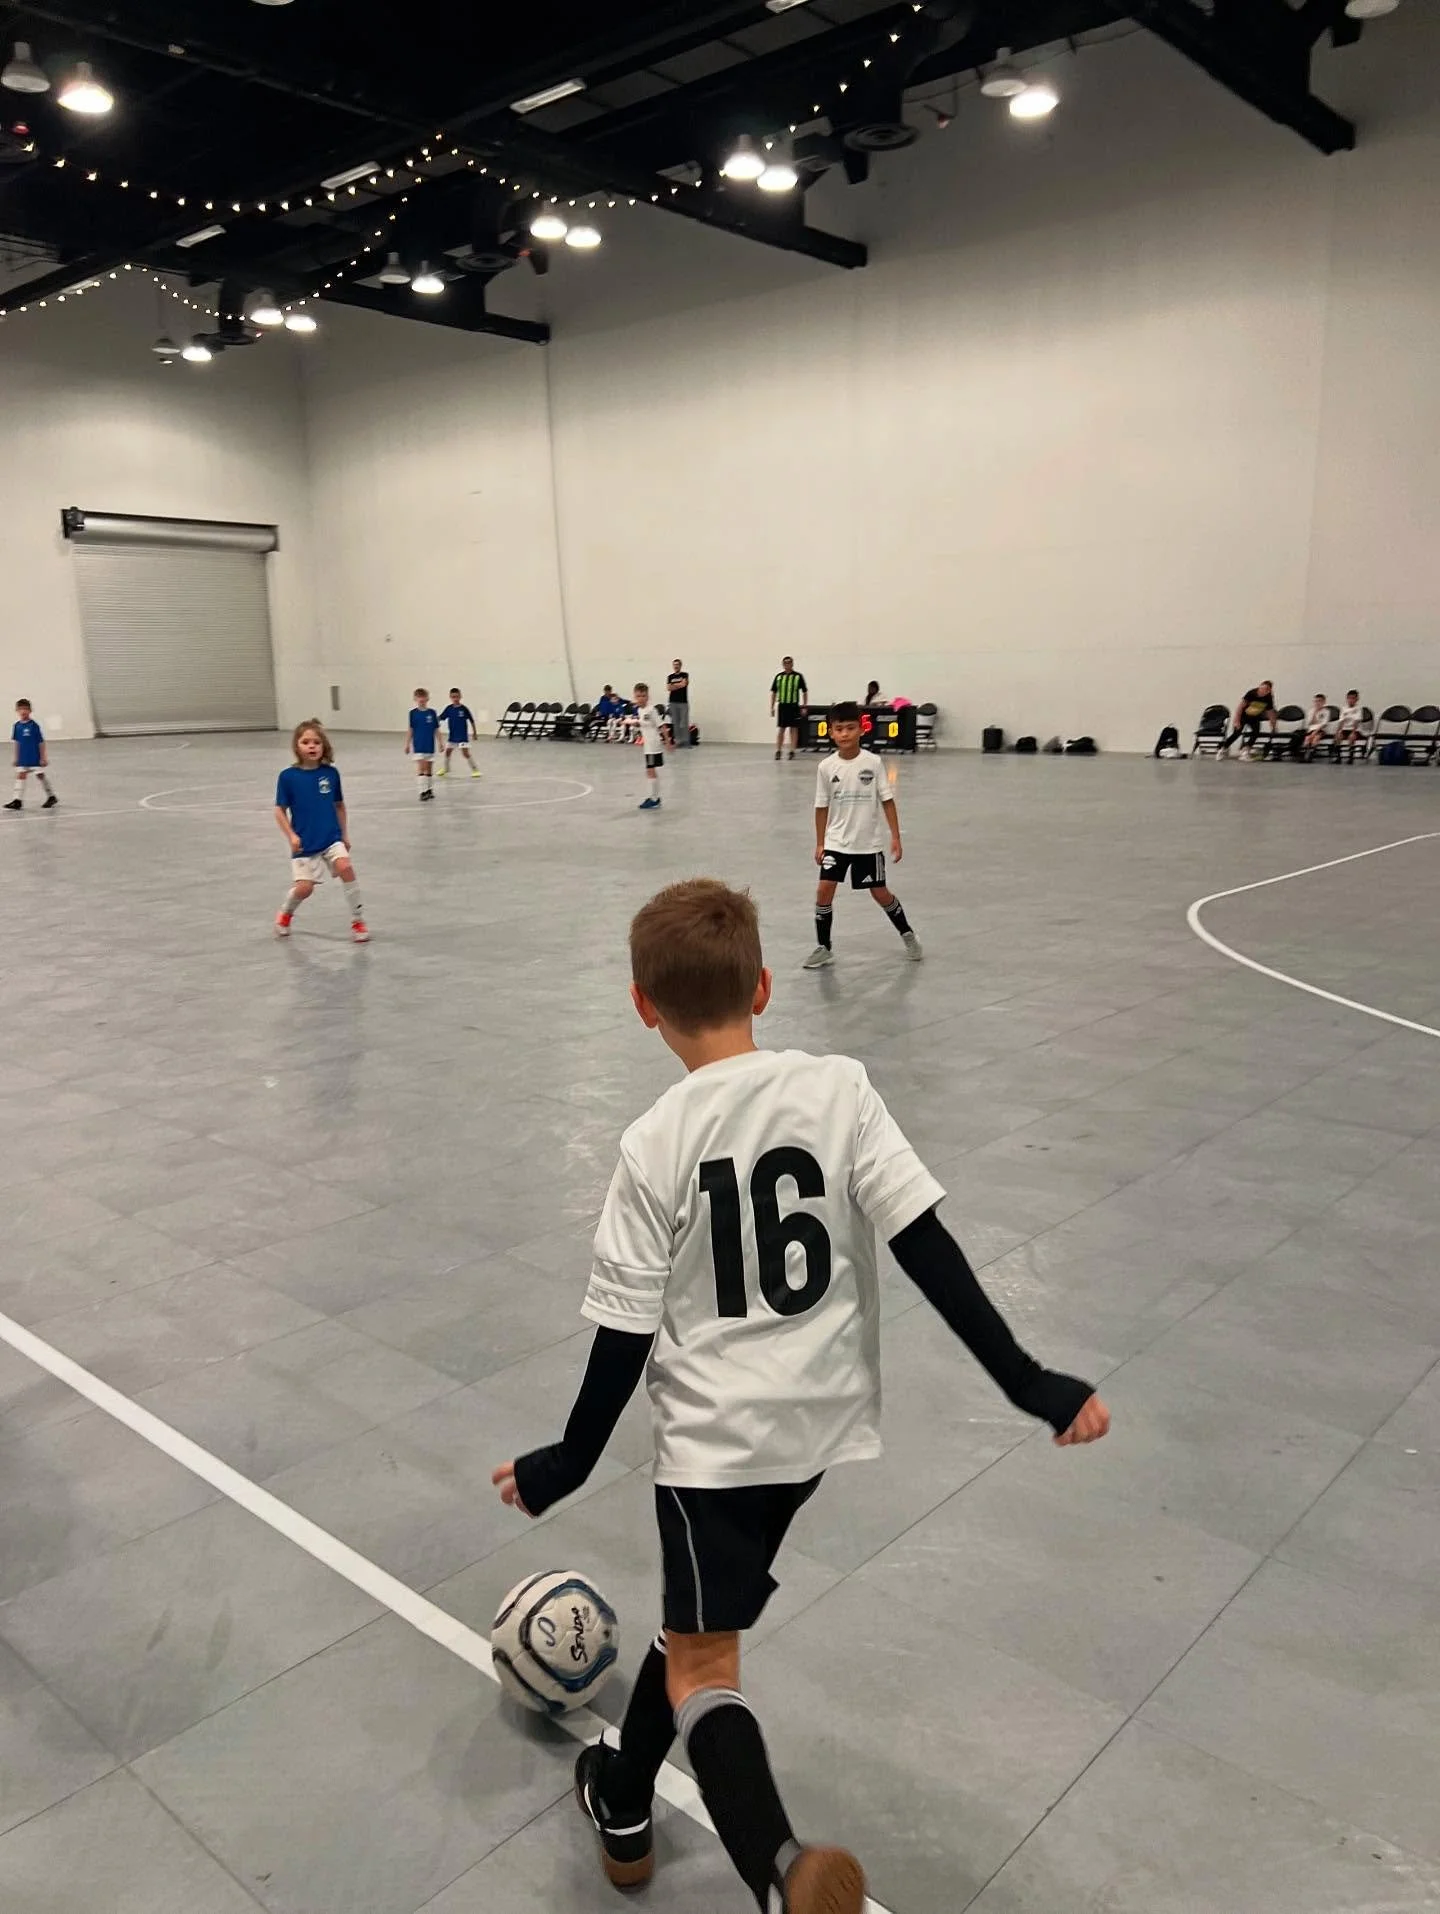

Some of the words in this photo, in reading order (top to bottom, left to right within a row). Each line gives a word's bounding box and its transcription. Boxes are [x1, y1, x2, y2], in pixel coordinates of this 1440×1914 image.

[818, 721, 828, 737] 0
[888, 722, 899, 738] 0
[699, 1146, 832, 1318] 16
